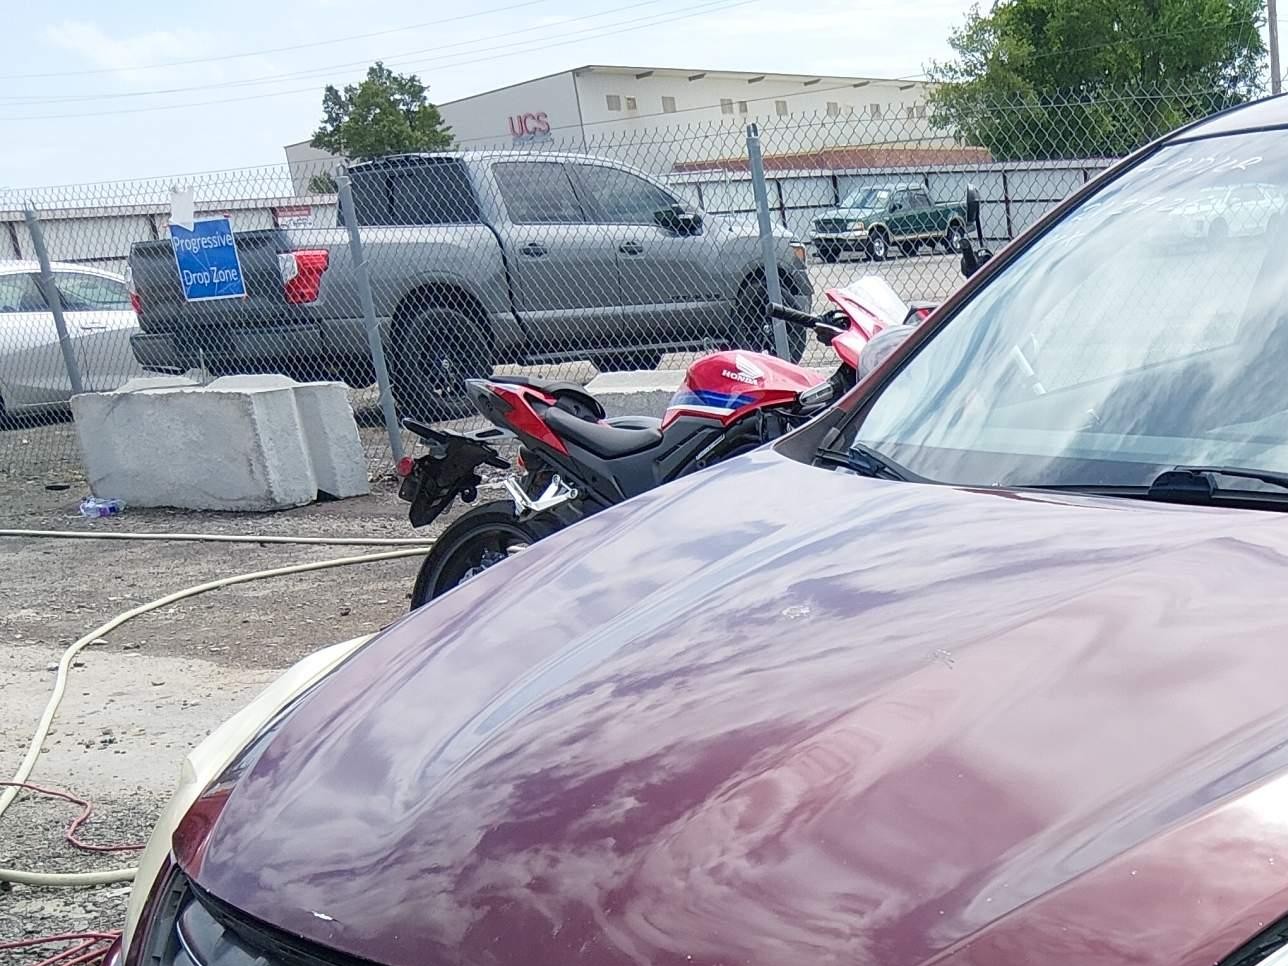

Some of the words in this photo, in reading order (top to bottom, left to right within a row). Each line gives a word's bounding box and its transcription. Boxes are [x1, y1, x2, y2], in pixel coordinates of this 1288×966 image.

[508, 111, 551, 136] UCS
[172, 231, 233, 254] Progressive
[183, 269, 211, 287] Drop
[210, 266, 239, 283] Zone
[721, 369, 758, 386] HONDA
